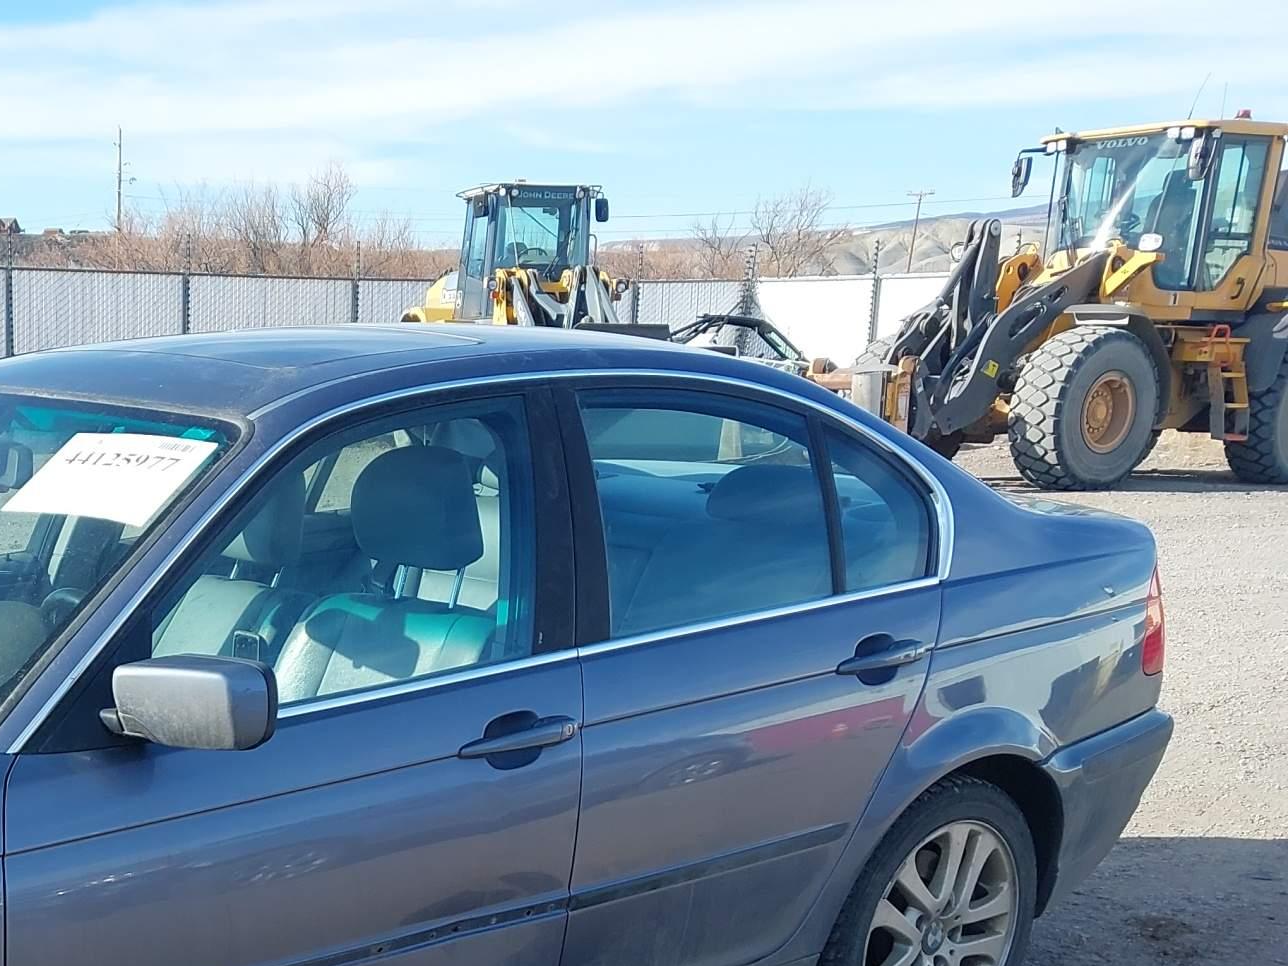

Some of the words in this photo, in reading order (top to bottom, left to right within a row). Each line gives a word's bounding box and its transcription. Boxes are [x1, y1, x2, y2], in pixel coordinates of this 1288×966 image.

[1095, 136, 1149, 150] VOLVO
[518, 190, 543, 199] JOHN
[544, 190, 574, 199] DEERE
[65, 450, 184, 471] 44125977
